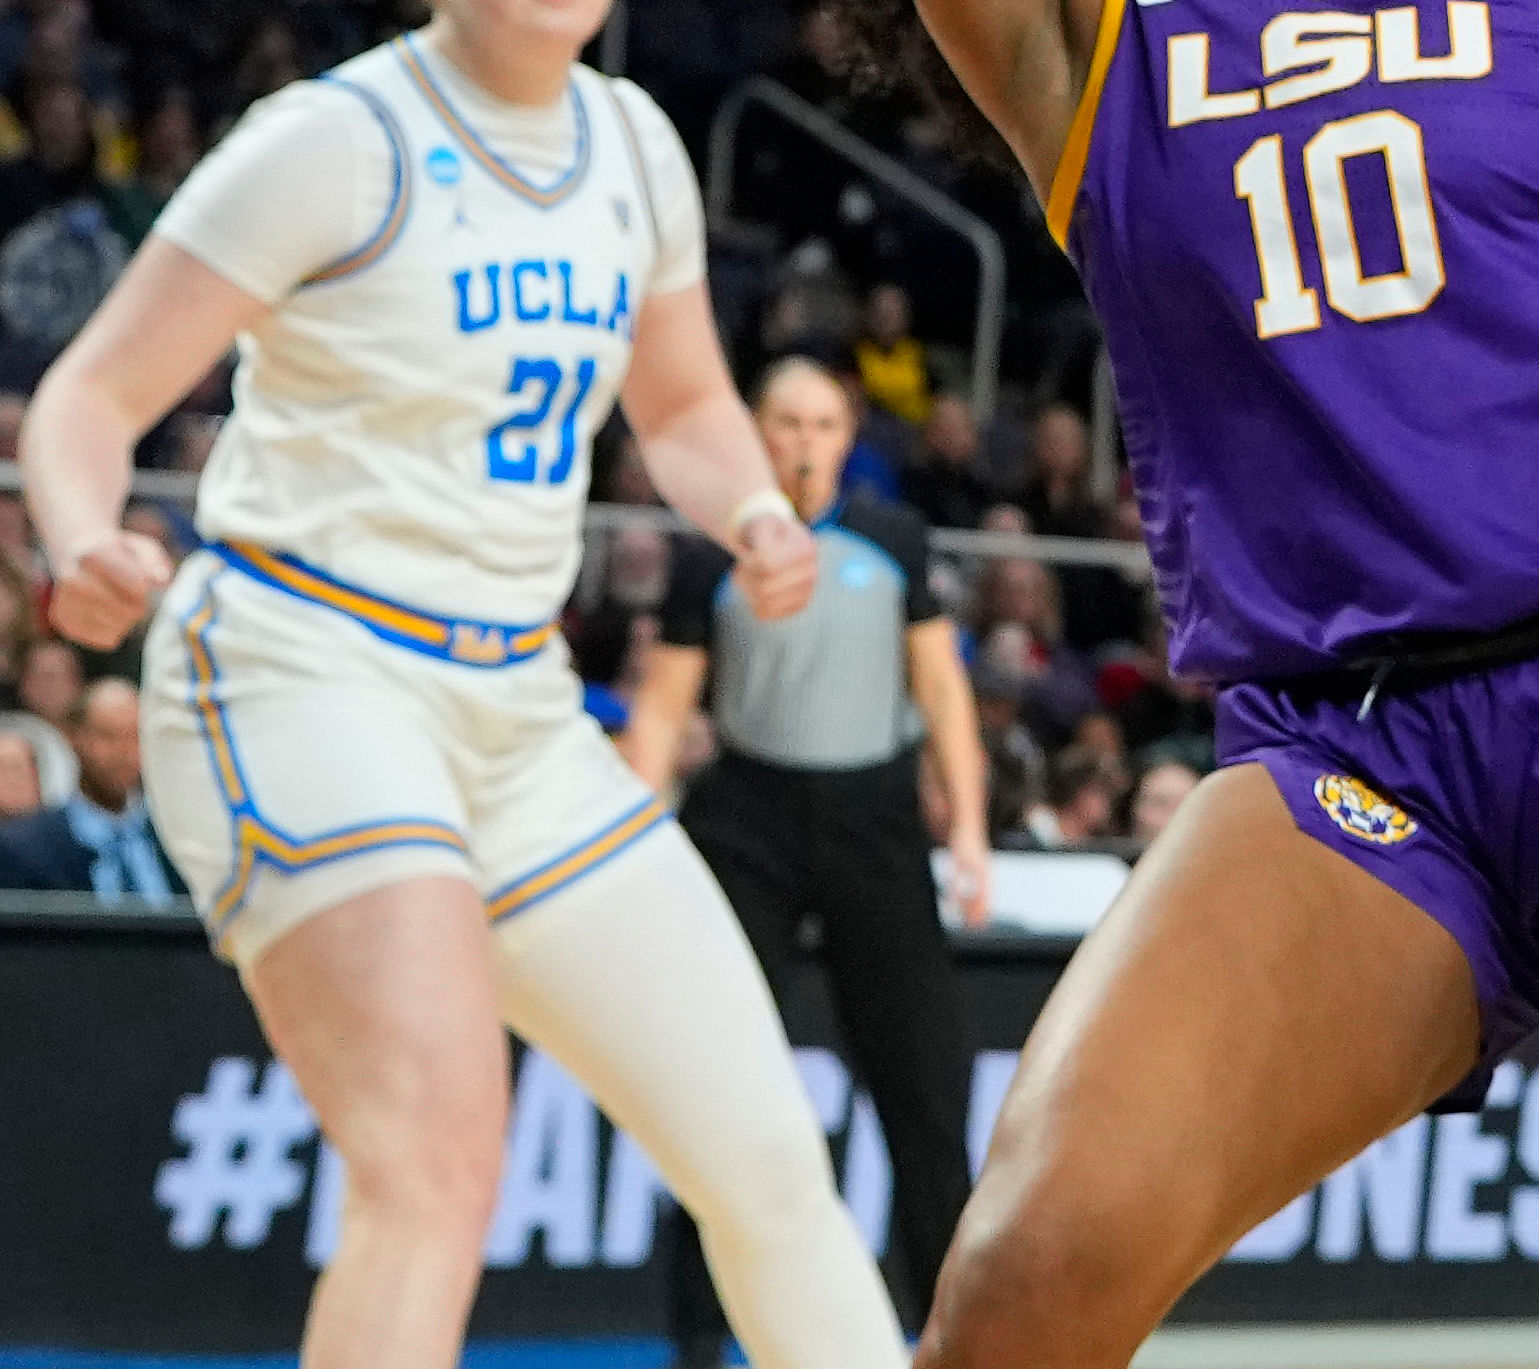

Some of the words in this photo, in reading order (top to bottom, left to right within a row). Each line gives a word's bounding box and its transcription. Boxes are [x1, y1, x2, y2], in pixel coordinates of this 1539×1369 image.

[1166, 0, 1494, 128] LSU
[1232, 110, 1447, 340] 10
[451, 257, 636, 343] UCLA
[487, 357, 597, 486] 21
